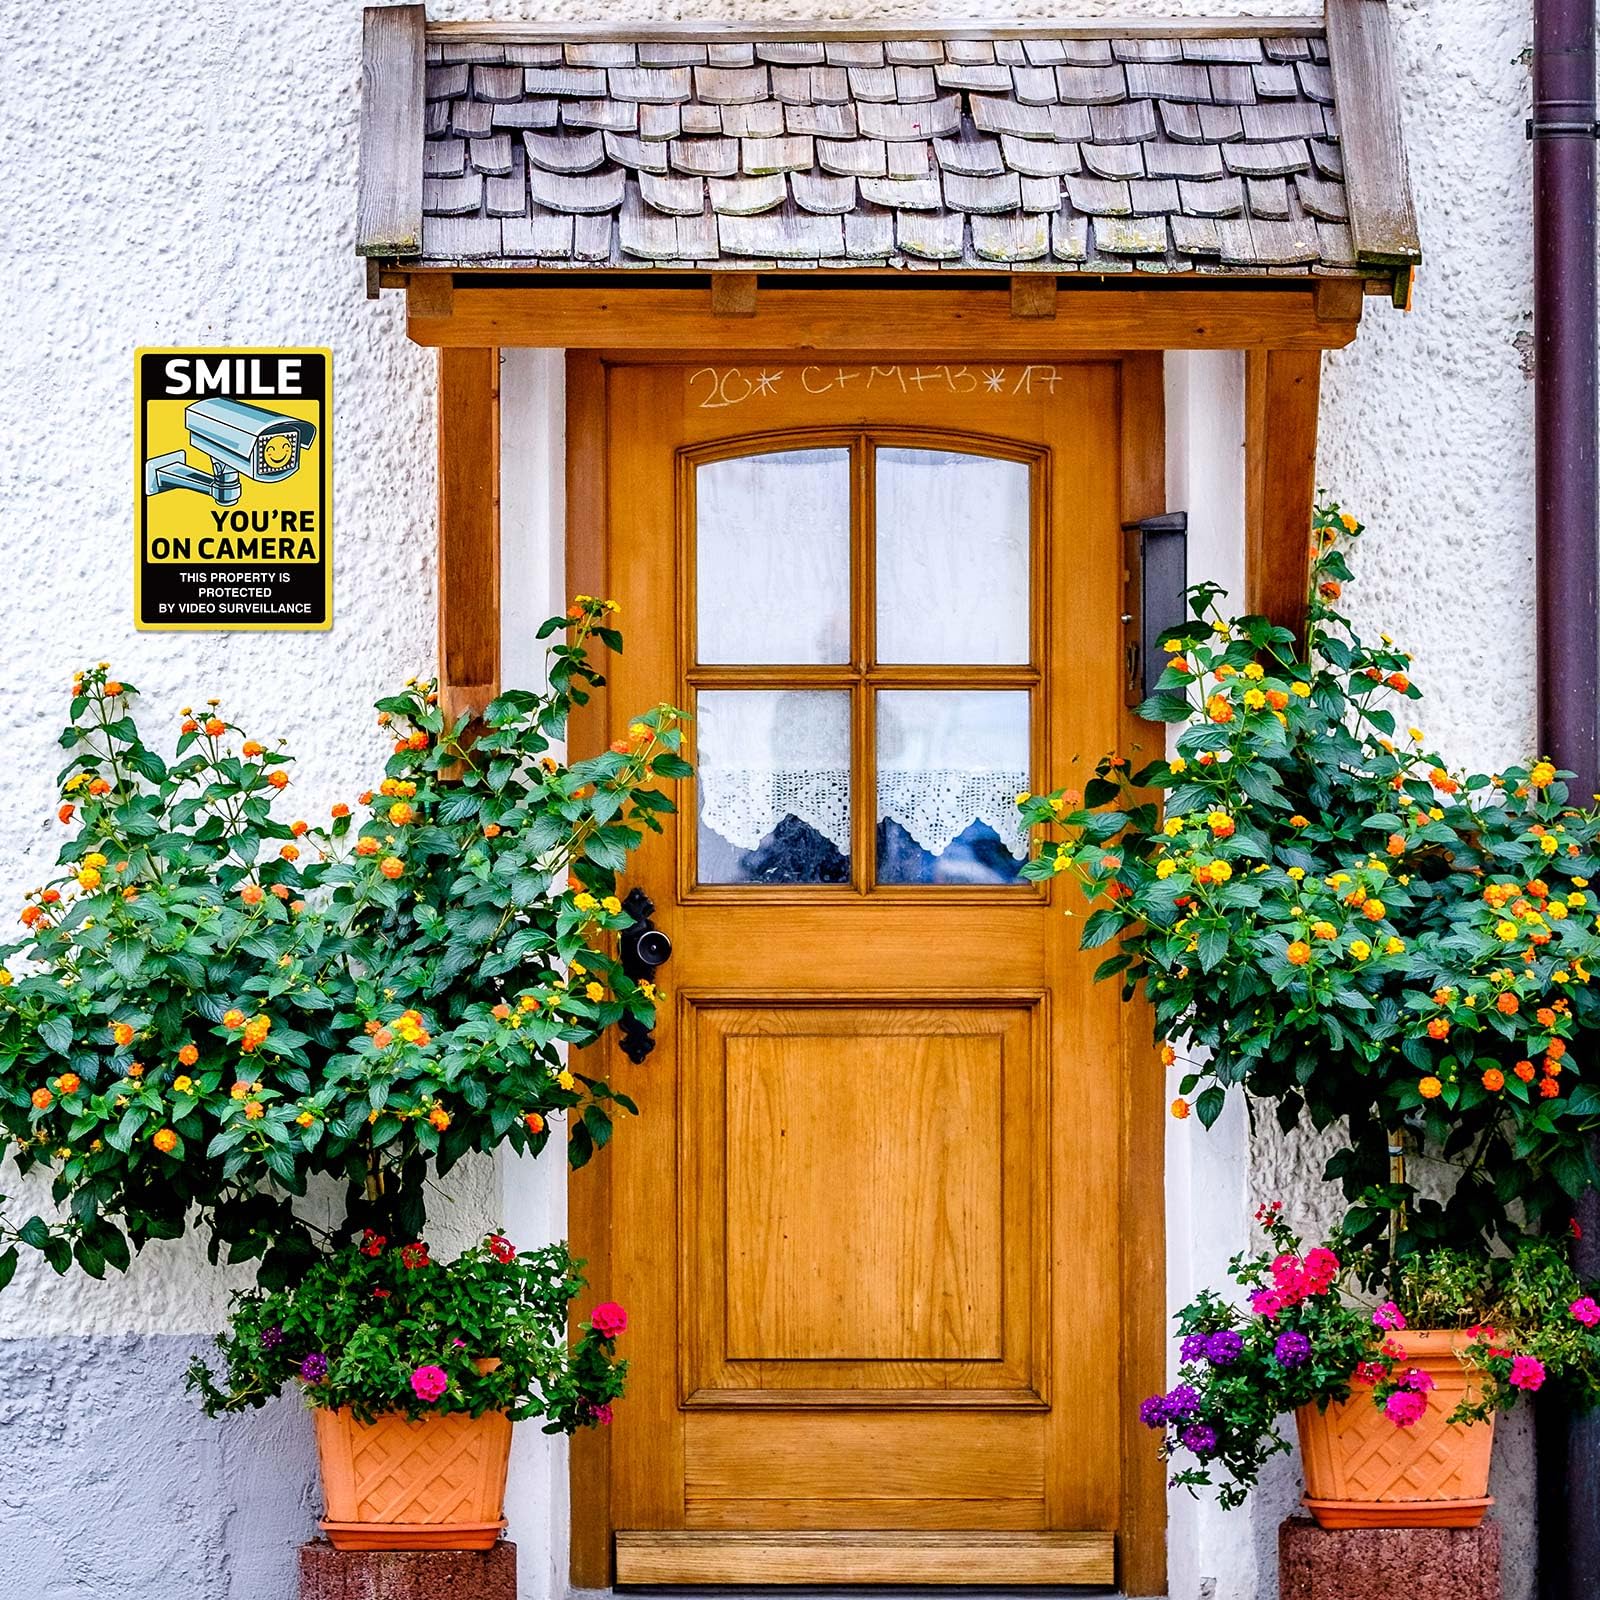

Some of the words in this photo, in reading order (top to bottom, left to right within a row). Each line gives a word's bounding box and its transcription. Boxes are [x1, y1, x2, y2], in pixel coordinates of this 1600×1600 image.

[165, 359, 302, 395] SMILE
[211, 510, 315, 532] YOU'RE
[151, 538, 191, 560] ON
[198, 538, 316, 560] CAMERA
[180, 572, 207, 582] THIS
[210, 572, 275, 582] PROPERTY
[279, 572, 290, 582] IS
[199, 588, 271, 597] PROTECTED
[159, 604, 175, 613] BY
[178, 603, 216, 613] VIDEO
[218, 603, 311, 613] SURVEILLANCE
